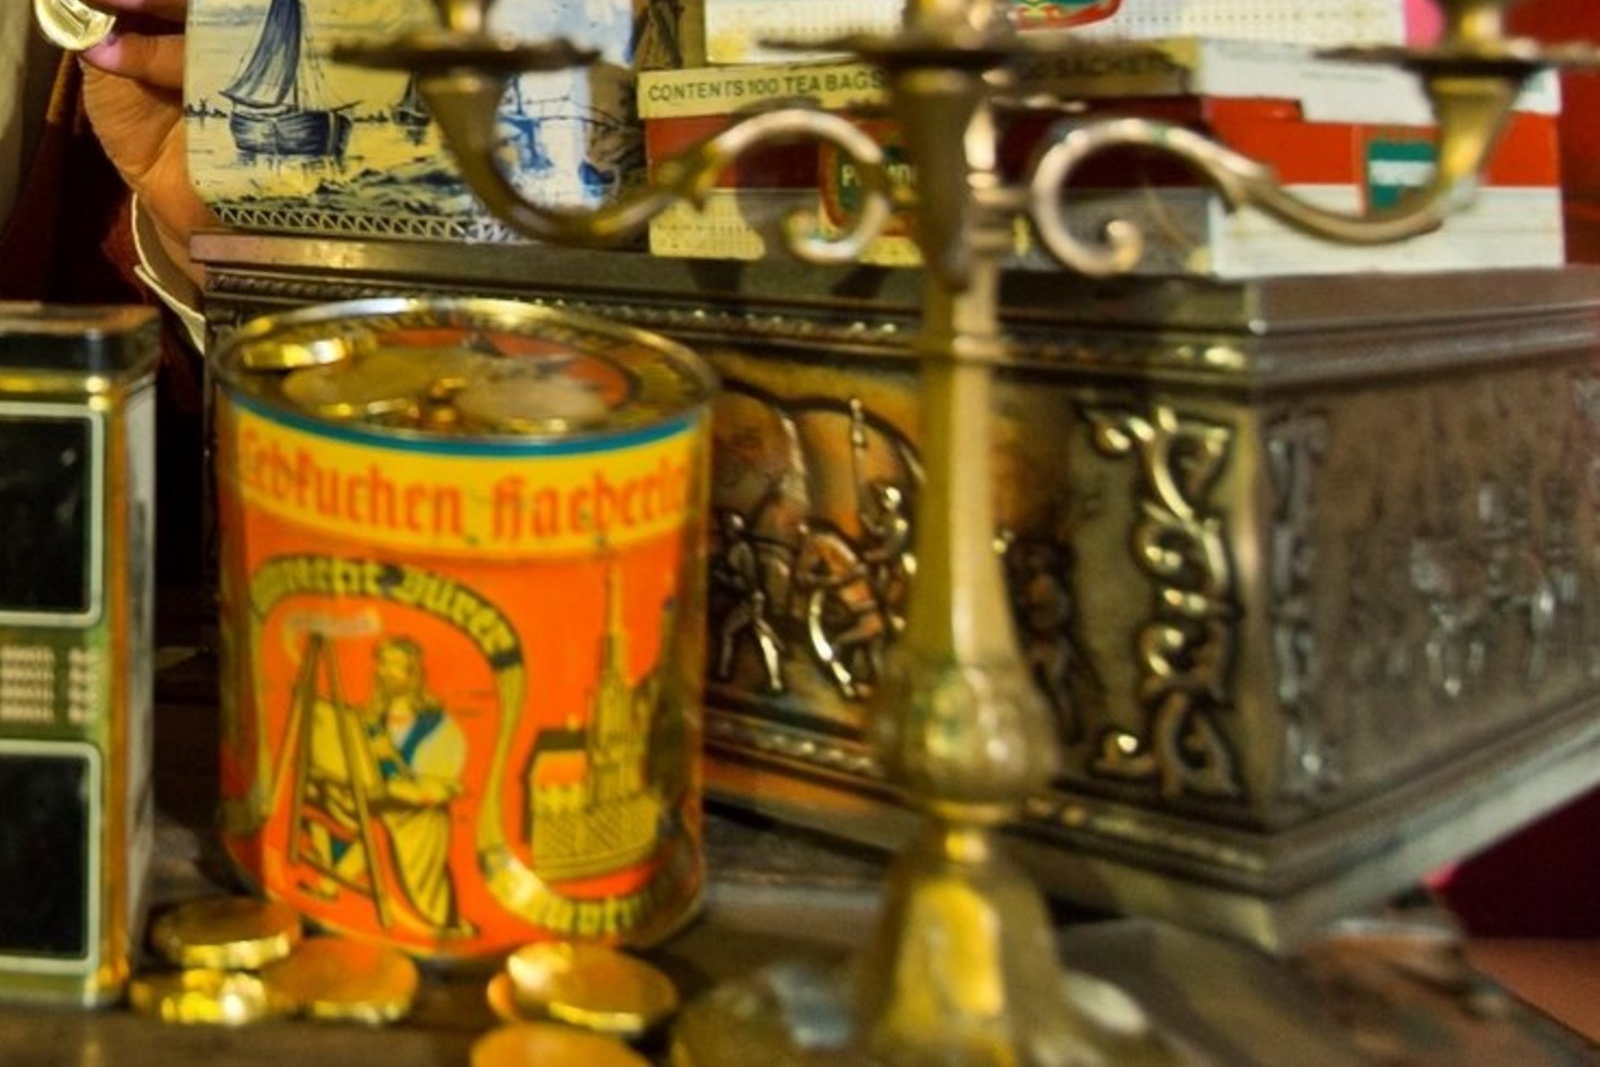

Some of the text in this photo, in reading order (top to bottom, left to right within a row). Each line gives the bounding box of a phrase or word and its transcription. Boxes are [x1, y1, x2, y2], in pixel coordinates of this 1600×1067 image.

[649, 79, 744, 102] CONTENTS
[748, 77, 779, 96] 100
[785, 75, 821, 95] TEA
[825, 69, 886, 92] BAGS
